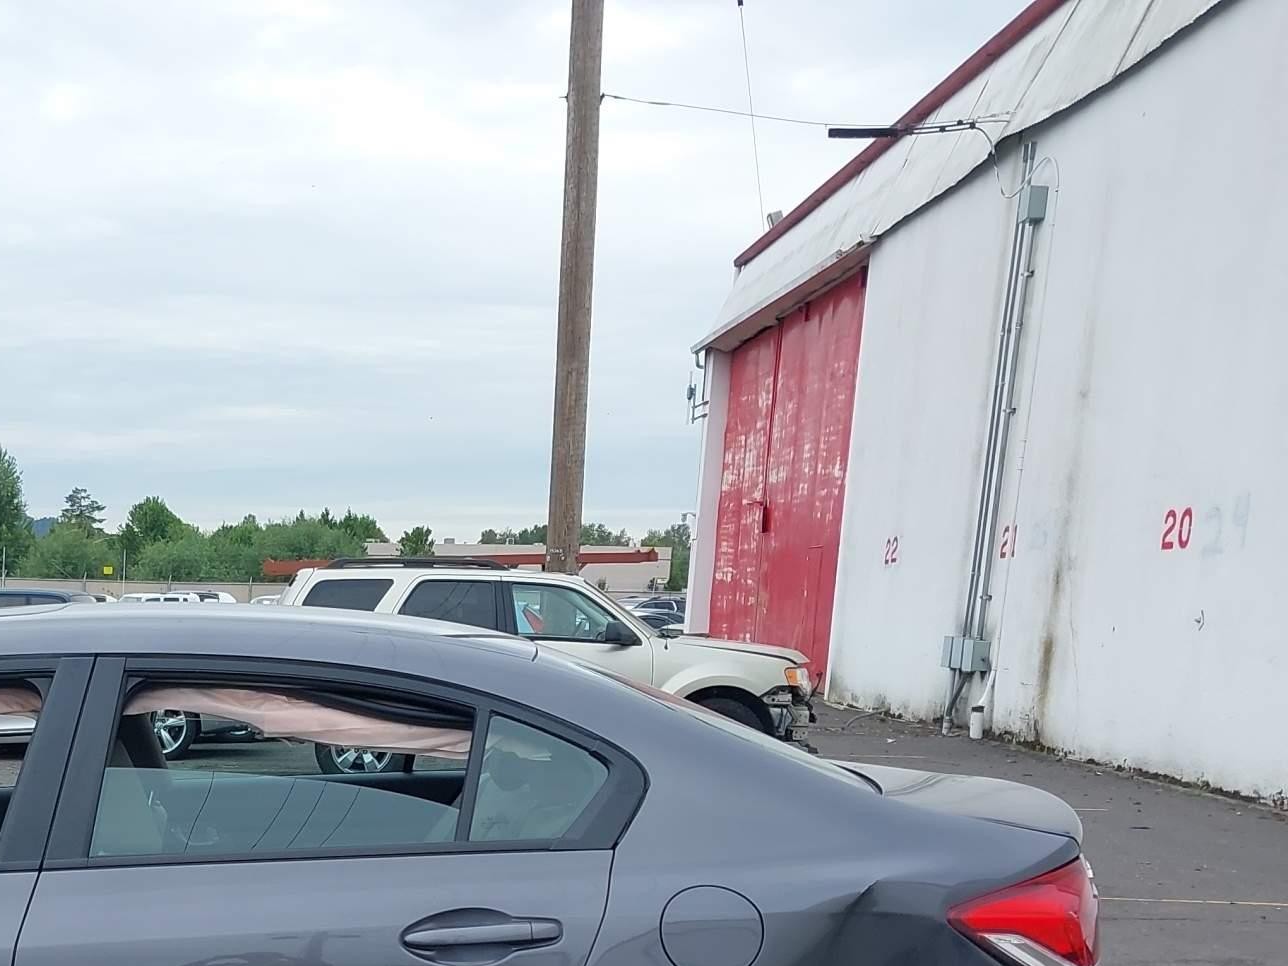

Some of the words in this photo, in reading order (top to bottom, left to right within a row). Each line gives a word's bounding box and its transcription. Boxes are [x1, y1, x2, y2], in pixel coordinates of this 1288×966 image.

[999, 524, 1018, 559] 21
[1161, 506, 1193, 551] 20
[884, 535, 899, 565] 22
